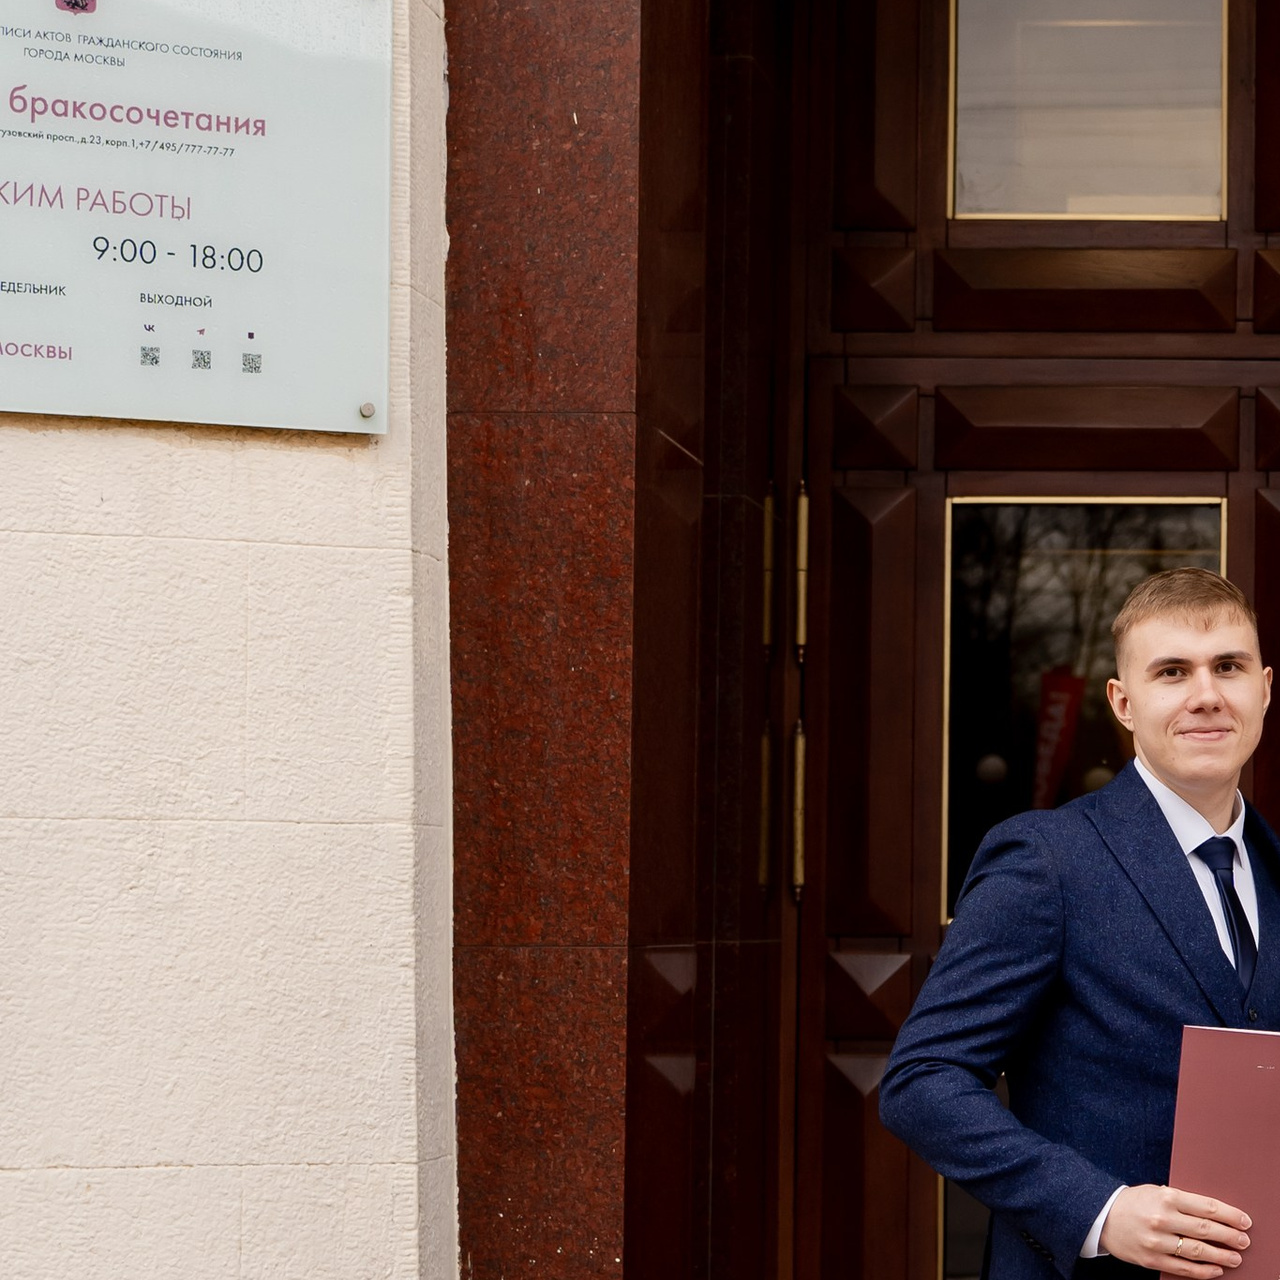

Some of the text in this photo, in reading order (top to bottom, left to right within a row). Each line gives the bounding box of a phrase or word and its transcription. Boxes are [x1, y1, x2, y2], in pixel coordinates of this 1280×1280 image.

[23, 47, 125, 67] ГОРОДА МОСКВЫ
[34, 30, 72, 43] АКТОВ
[77, 34, 169, 53] ГРАЖДАНСКОГО
[172, 45, 242, 61] СОСТОЯНИЯ
[9, 84, 266, 137] бракосочетания
[0, 129, 44, 139] узовский
[76, 187, 191, 221] РАБОТЫ
[93, 236, 157, 264] 9:00
[190, 244, 263, 273] 18:00
[0, 281, 212, 308] ЕДЕЛЬНИК ВЫХОДНОЙ
[0, 342, 72, 360] ОСКВЫ
